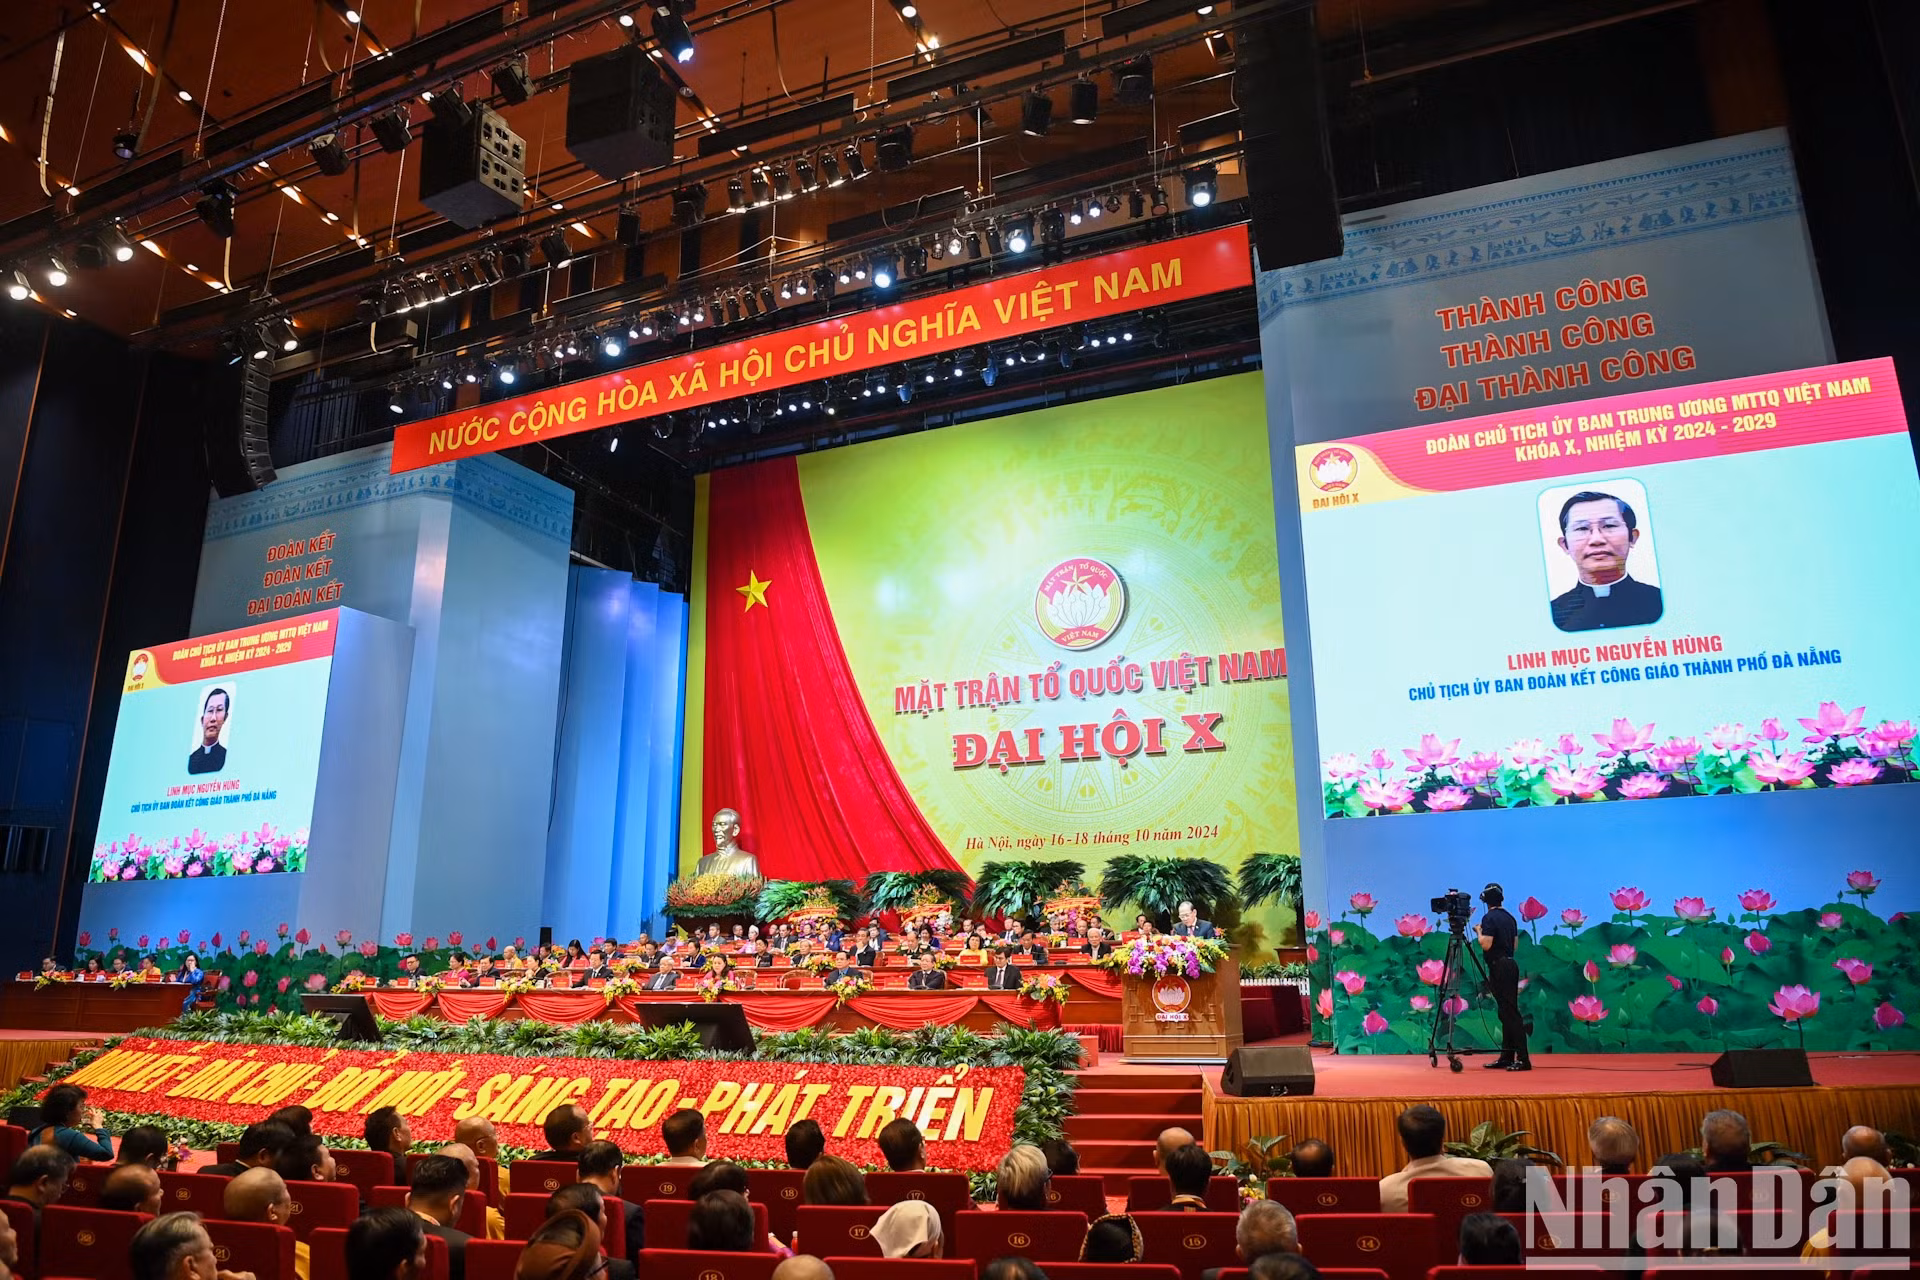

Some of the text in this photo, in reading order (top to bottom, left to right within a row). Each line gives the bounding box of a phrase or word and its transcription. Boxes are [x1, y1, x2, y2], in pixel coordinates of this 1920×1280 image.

[1436, 275, 1648, 331] THÀNH CÔNG
[428, 258, 1182, 454] NƯỚC CỘNG HÒA XÃ HỘI CHỦ NGHĨA VIỆT NAM
[1441, 312, 1655, 368] THÀNH CÔNG
[1415, 346, 1696, 412] ĐẠI THÀNH CÔNG
[1425, 376, 1872, 455] ĐOÀN CHỦ TỊCH ỦY BAN TRUNG ƯƠNG MTTQ VIỆT NAM
[1515, 440, 1561, 462] KHÓA
[1565, 439, 1582, 456] X,
[1585, 430, 1642, 453] NHIỆM
[1645, 423, 1668, 444] KỲ
[1673, 420, 1717, 441] 2024
[1732, 412, 1777, 433] 2029
[1352, 492, 1360, 503] X
[263, 555, 333, 588] ĐOÀN KẾT
[267, 529, 336, 562] ĐOÀN KẾT
[247, 578, 344, 617] ĐẠI ĐOÀN KẾT
[1081, 630, 1099, 638] NAM
[1507, 634, 1723, 671] LINH MỤC NGUYỄN HÙNG
[895, 648, 1287, 716] MẶT TRẬN TỔ QUỐC VIỆT NAM
[1408, 646, 1842, 701] CHỦ TỊCH ỦY BAN ĐOÀN KẾT CÔNG GIÁO THÀNH PHỐ ĐÀ NẴNG
[952, 708, 1225, 773] ĐẠI HỘI X
[966, 836, 984, 850] Hà
[988, 835, 1013, 852] Nội,
[1016, 836, 1046, 851] ngày
[1093, 829, 1130, 846] tháng
[1135, 828, 1150, 842] 10
[1153, 827, 1182, 841] năm
[1187, 824, 1219, 839] 2024
[832, 1064, 994, 1142] TRIỂN
